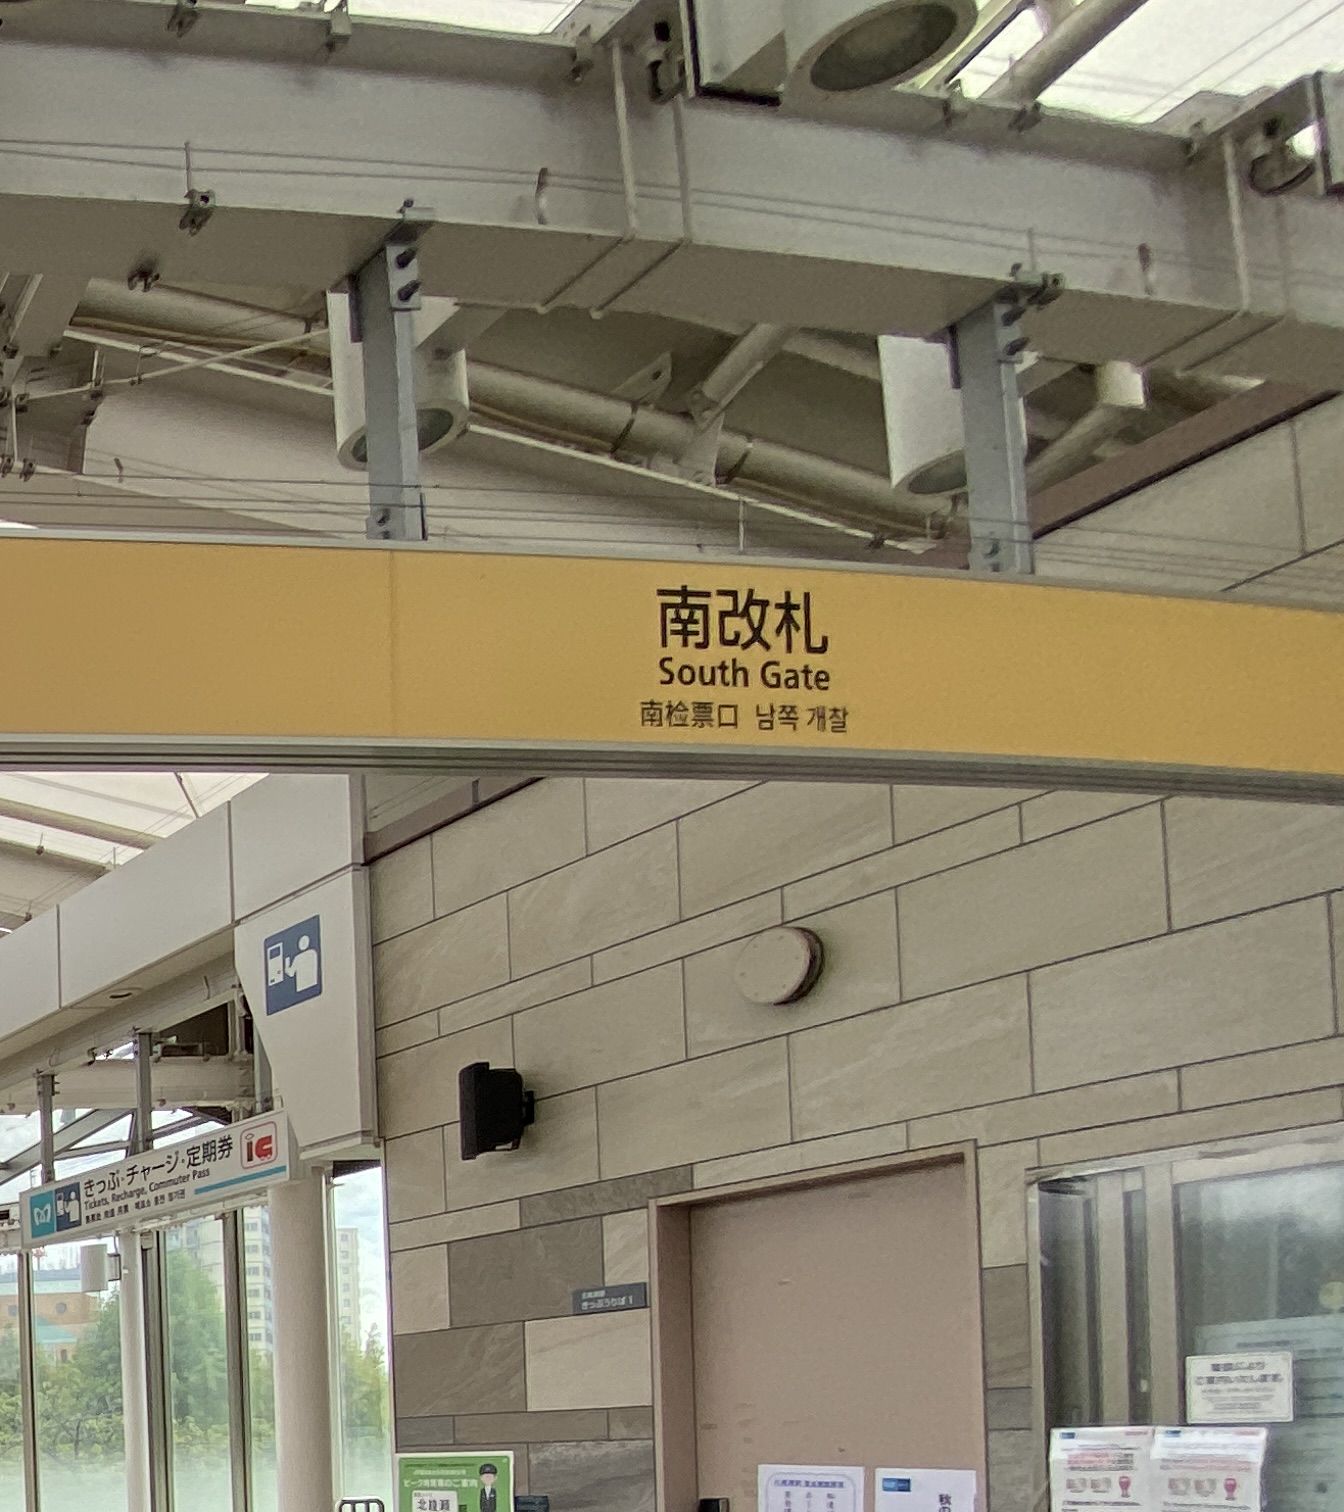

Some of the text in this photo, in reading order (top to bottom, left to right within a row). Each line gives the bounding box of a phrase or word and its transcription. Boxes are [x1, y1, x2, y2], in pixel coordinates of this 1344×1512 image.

[656, 585, 829, 655] 南改札
[659, 656, 830, 691] South Gate
[640, 700, 739, 729] 南检票口
[149, 1174, 190, 1192] Commuter
[192, 1168, 210, 1181] Pass
